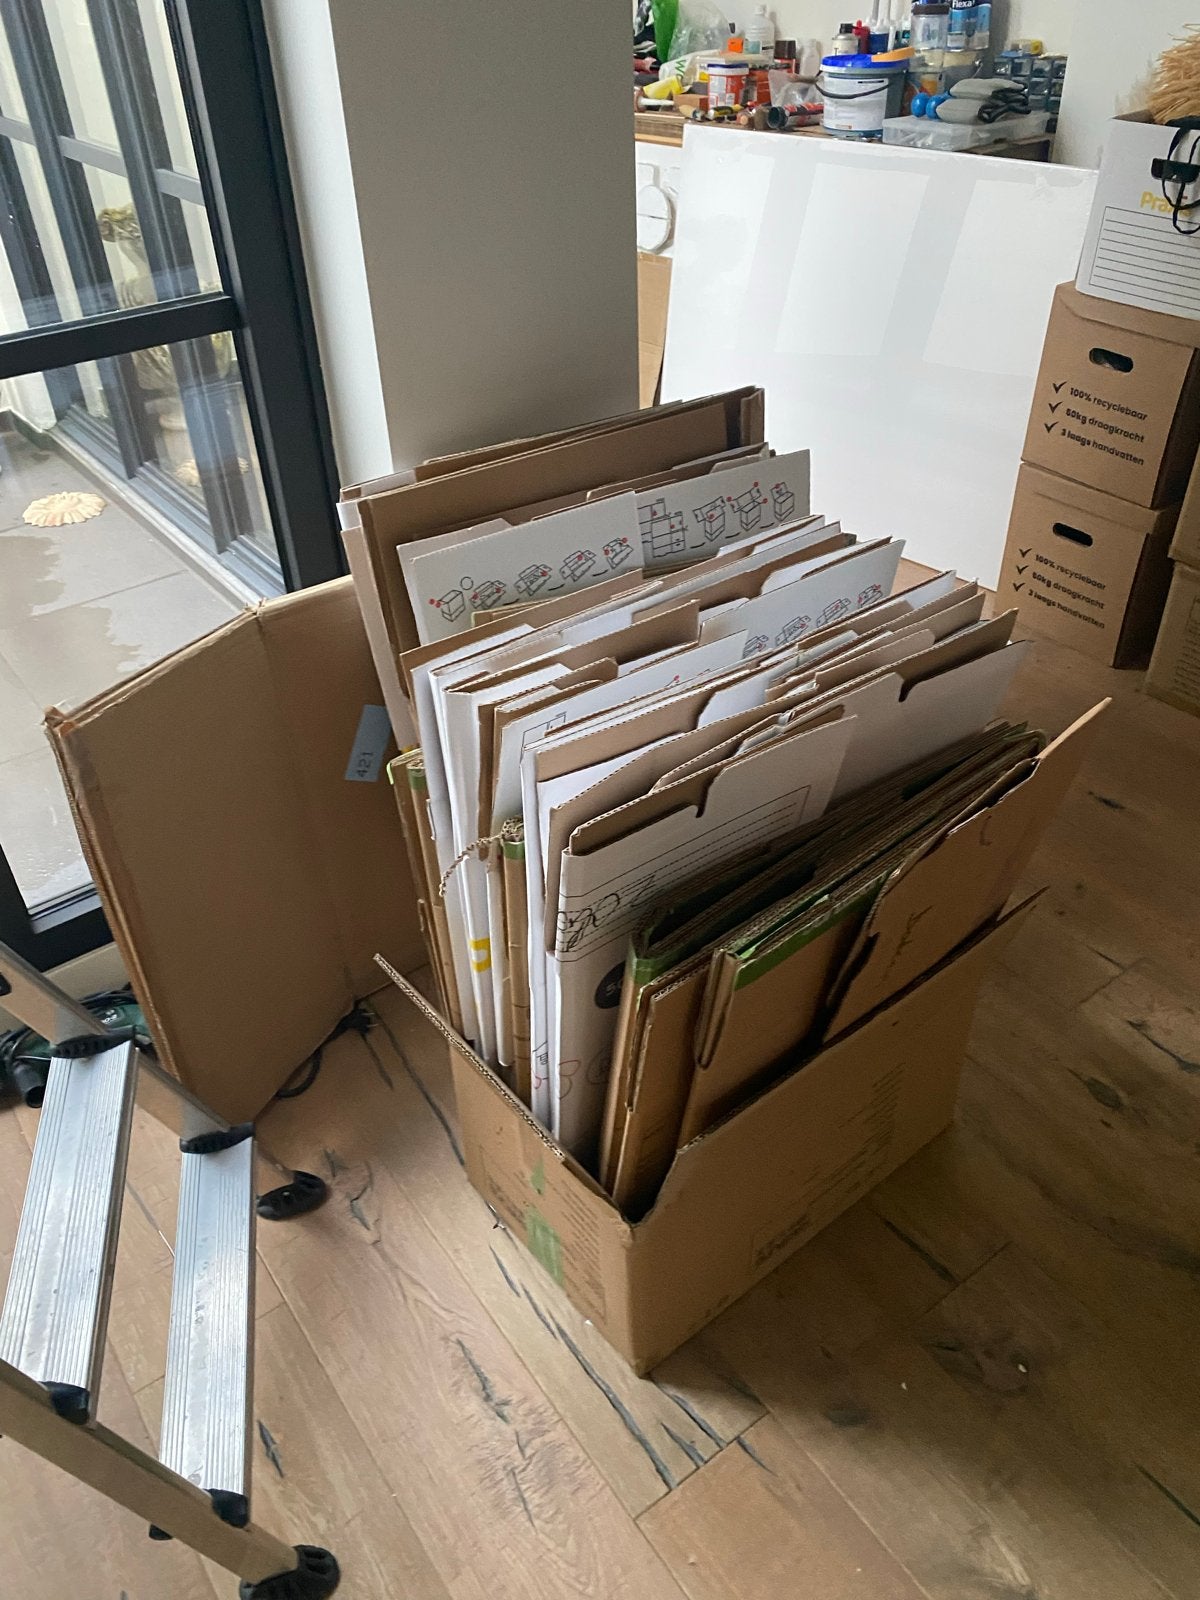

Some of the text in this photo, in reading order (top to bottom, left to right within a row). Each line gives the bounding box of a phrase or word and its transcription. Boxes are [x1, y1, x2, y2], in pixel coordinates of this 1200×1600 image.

[1070, 387, 1148, 420] 100% recyclebaar
[1088, 417, 1145, 443] draagkracht
[1067, 430, 1091, 446] laags
[1092, 440, 1144, 466] handvatten
[1035, 554, 1106, 590] 100% recyclebaar
[1053, 583, 1105, 610] draagkracht
[1057, 602, 1105, 629] handvatten
